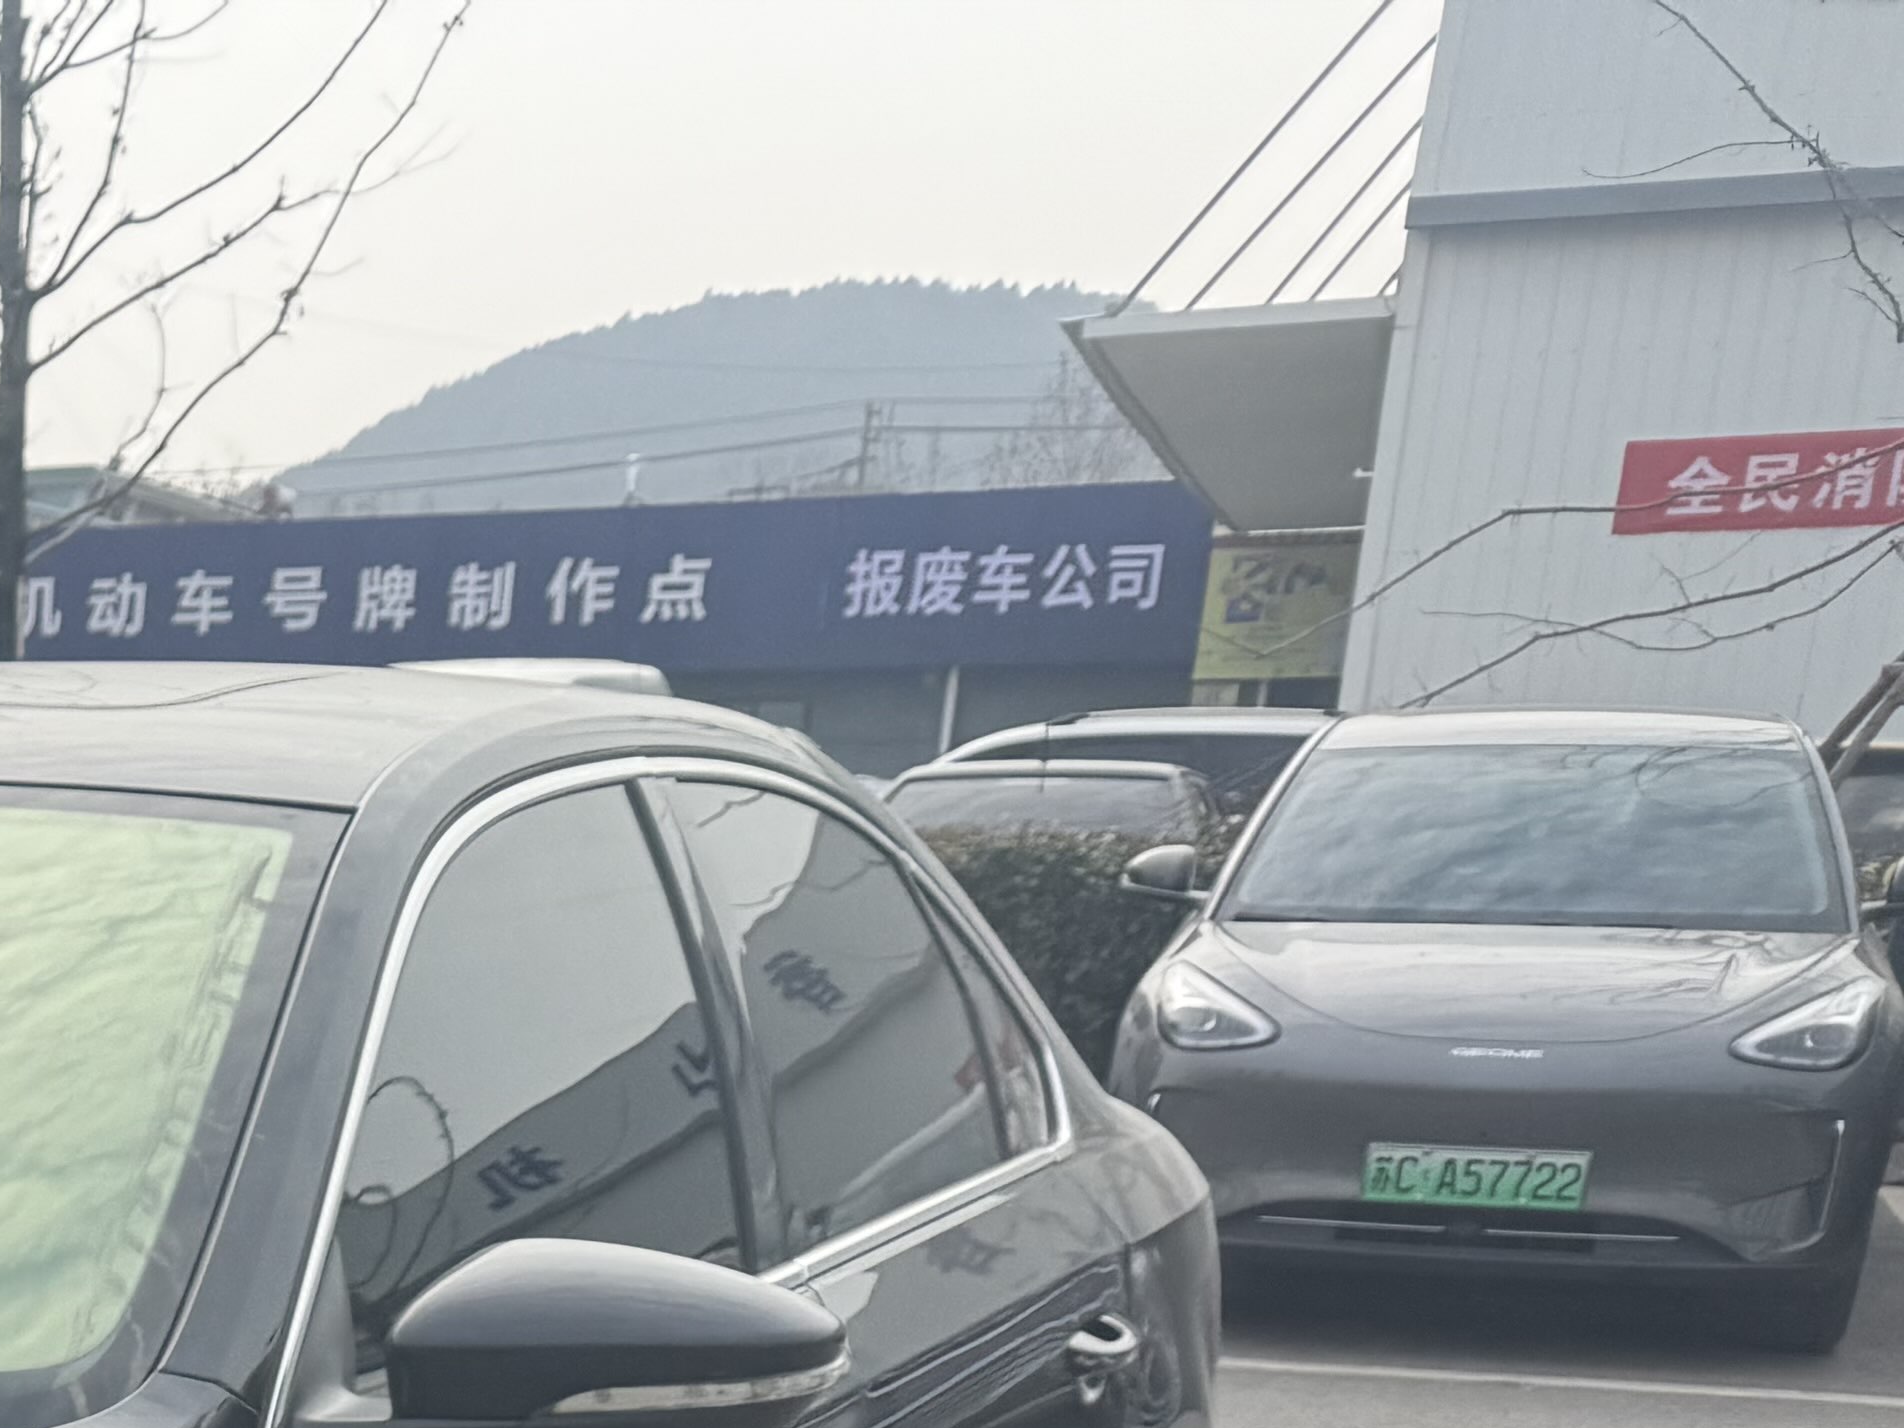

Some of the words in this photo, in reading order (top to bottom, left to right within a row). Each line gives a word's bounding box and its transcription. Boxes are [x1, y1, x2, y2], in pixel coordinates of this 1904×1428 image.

[1666, 447, 1904, 516] 全民消
[842, 543, 1165, 619] 报废车公司
